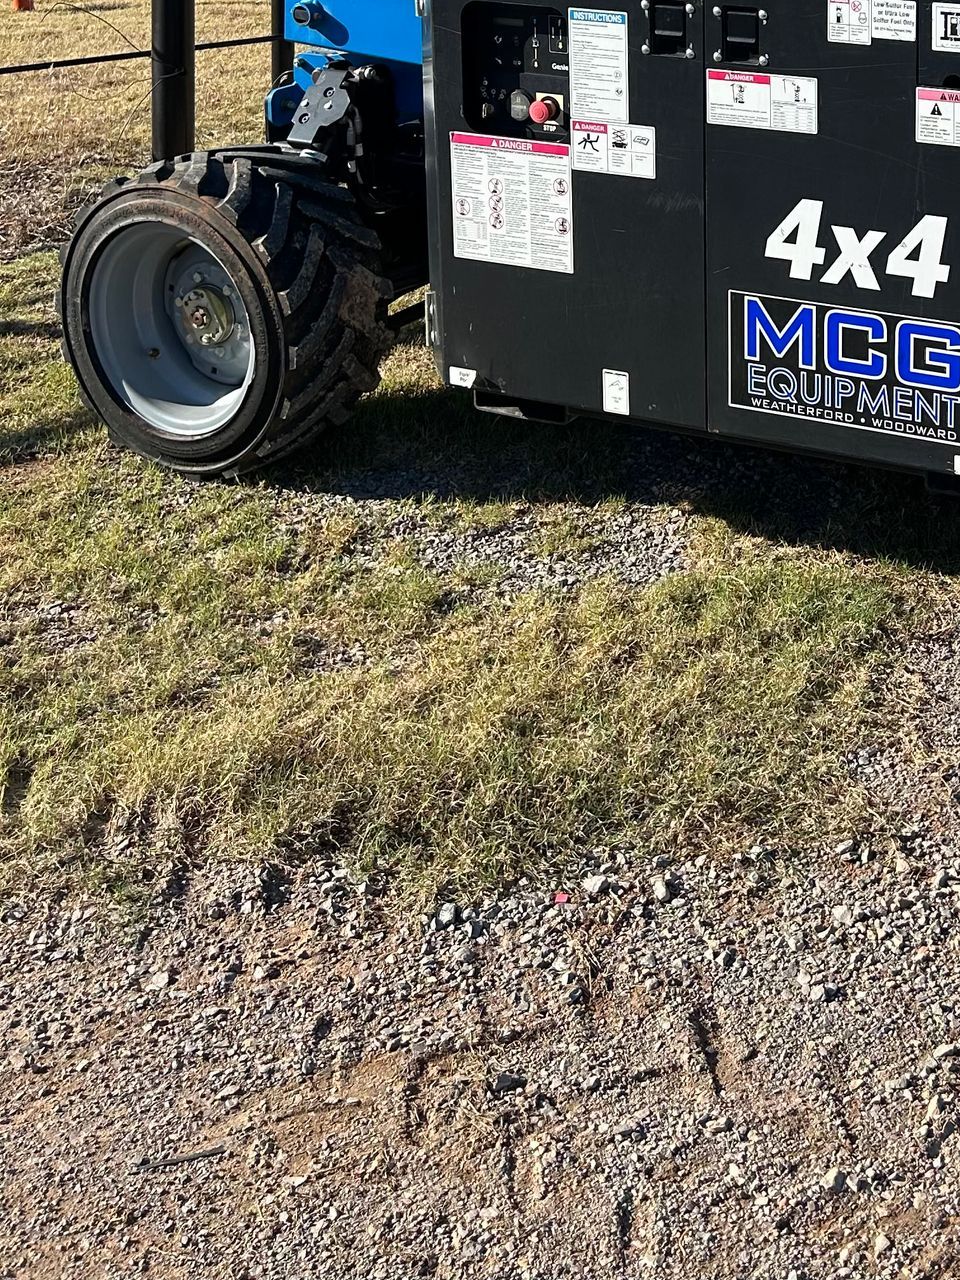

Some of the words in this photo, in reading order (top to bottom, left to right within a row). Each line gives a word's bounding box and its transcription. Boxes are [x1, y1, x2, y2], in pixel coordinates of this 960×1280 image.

[573, 11, 622, 23] INSTRUCTIONS
[729, 73, 754, 81] DANGER
[543, 124, 557, 132] STOP
[581, 123, 605, 131] DANGER
[499, 139, 533, 151] DANGER
[764, 198, 951, 299] 4x4
[747, 362, 960, 429] EQUIPMENT
[751, 397, 854, 423] WEATHERFORD
[871, 417, 957, 441] WOODWARD
